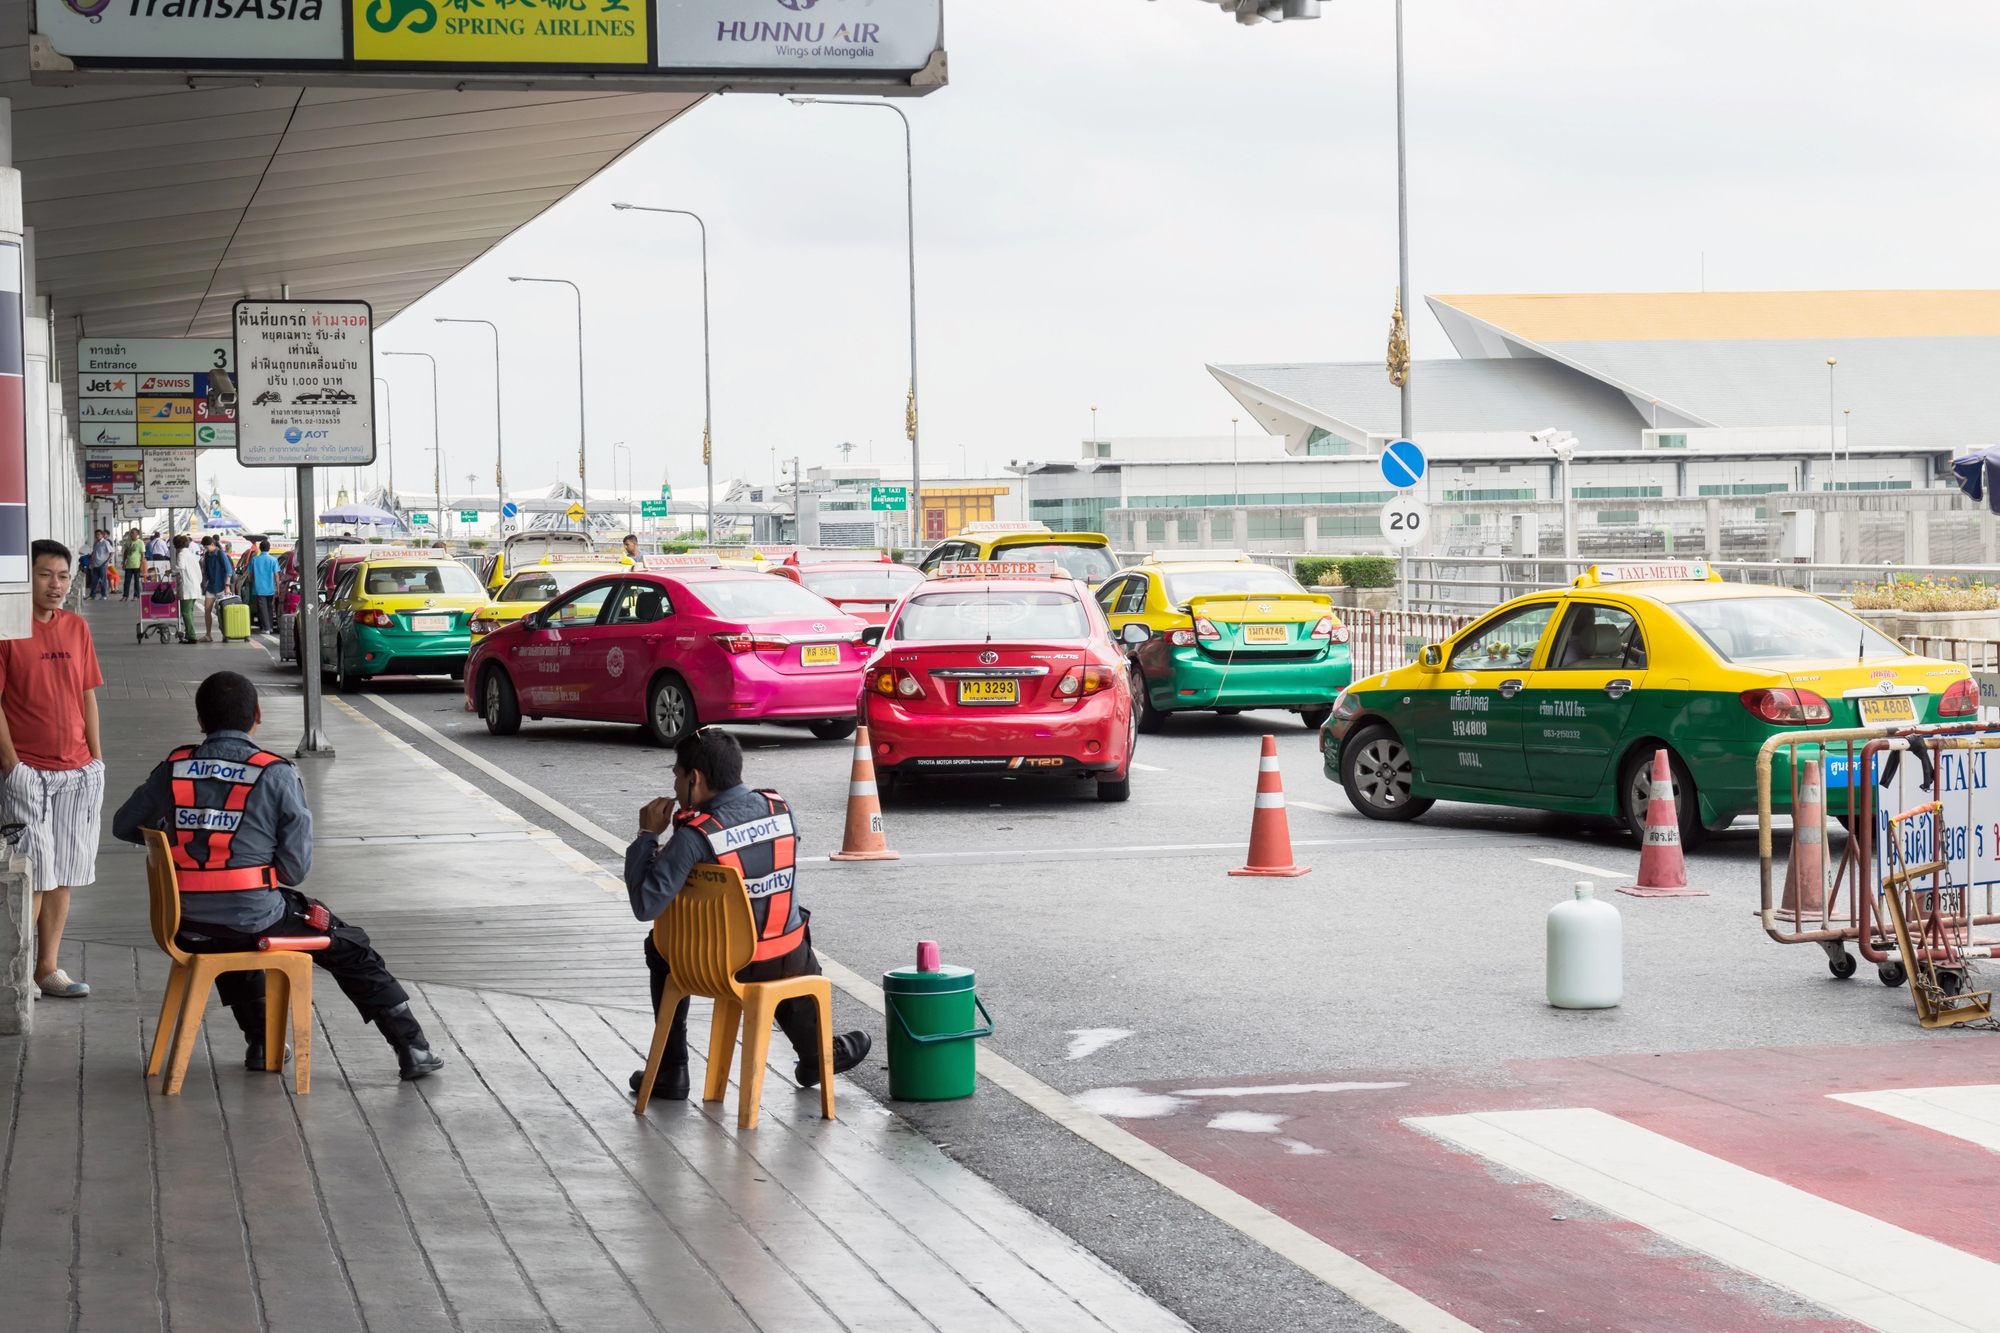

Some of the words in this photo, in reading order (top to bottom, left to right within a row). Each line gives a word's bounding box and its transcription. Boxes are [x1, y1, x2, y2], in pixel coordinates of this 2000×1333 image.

[445, 17, 525, 35] SPRING
[534, 19, 635, 37] AIRLINES
[716, 21, 825, 43] HUNNU
[832, 22, 880, 43] AIR
[775, 45, 810, 58] Wings
[811, 45, 822, 56] of
[823, 46, 875, 59] Mongolia
[311, 311, 368, 326] ห้ามจอด
[89, 344, 127, 355] ทางเข้า
[288, 342, 320, 355] เท่านั้น
[90, 360, 138, 369] Entrance
[213, 348, 228, 369] 3
[86, 379, 112, 392] Jet
[157, 379, 191, 388] SWISS
[267, 375, 288, 385] ปรับ
[323, 377, 343, 385] บาท
[97, 408, 134, 416] JetAsia
[174, 406, 193, 415] UIA
[304, 430, 329, 439] AOT
[1390, 512, 1420, 530] 20
[504, 524, 516, 532] 20
[653, 556, 707, 566] TAXI-METER
[956, 563, 1038, 574] TAXI-METER
[1617, 565, 1689, 580] TAXI-METER
[1265, 626, 1284, 636] 4746
[40, 651, 72, 660] JEANS
[819, 647, 837, 656] 3943
[963, 682, 981, 694] ทว
[985, 682, 1014, 694] 3293
[1554, 700, 1574, 717] TAXI
[1883, 699, 1910, 713] 4808
[1026, 758, 1064, 767] TRD
[186, 760, 247, 780] Airport
[177, 809, 239, 830] Security
[724, 817, 780, 847] Airport
[744, 871, 792, 895] ecurity
